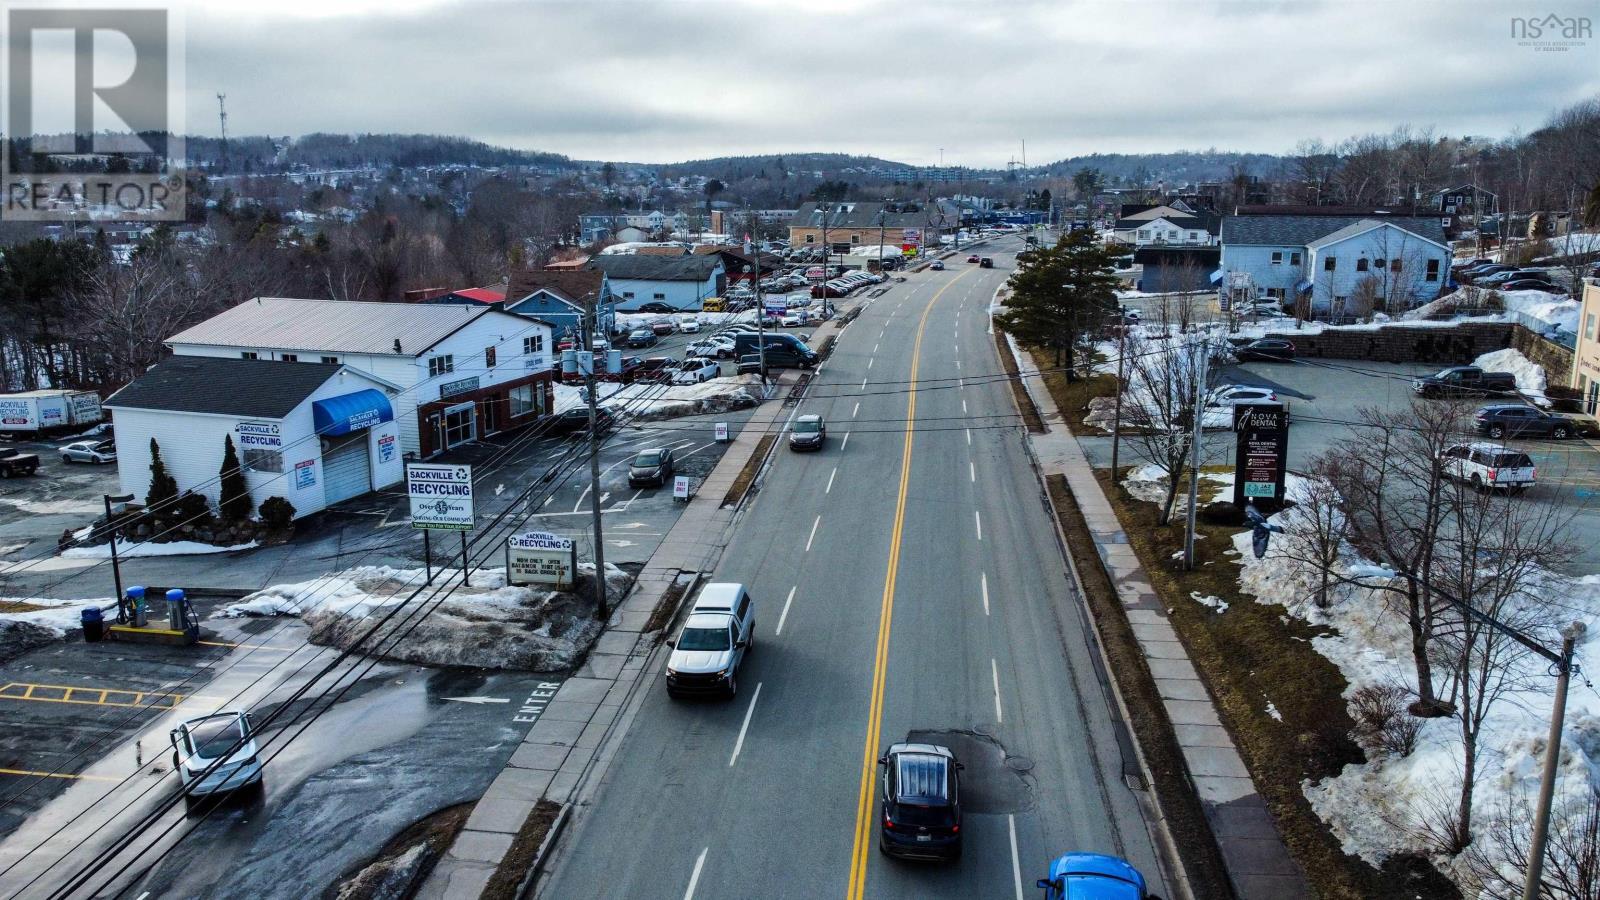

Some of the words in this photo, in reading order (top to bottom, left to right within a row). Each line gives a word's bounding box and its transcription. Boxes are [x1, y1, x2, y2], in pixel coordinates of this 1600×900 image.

[0, 401, 28, 409] ACKVILLE
[239, 424, 270, 434] SACKVILLE
[350, 418, 380, 431] RECYCLING
[241, 435, 282, 447] RECYCLING
[410, 471, 453, 480] SACKVILLE
[410, 483, 470, 496] RECYCLING
[419, 503, 435, 511] Over
[526, 533, 554, 541] SACKVILLE
[519, 539, 561, 549] RECYCLING
[512, 682, 561, 722] ENTER
